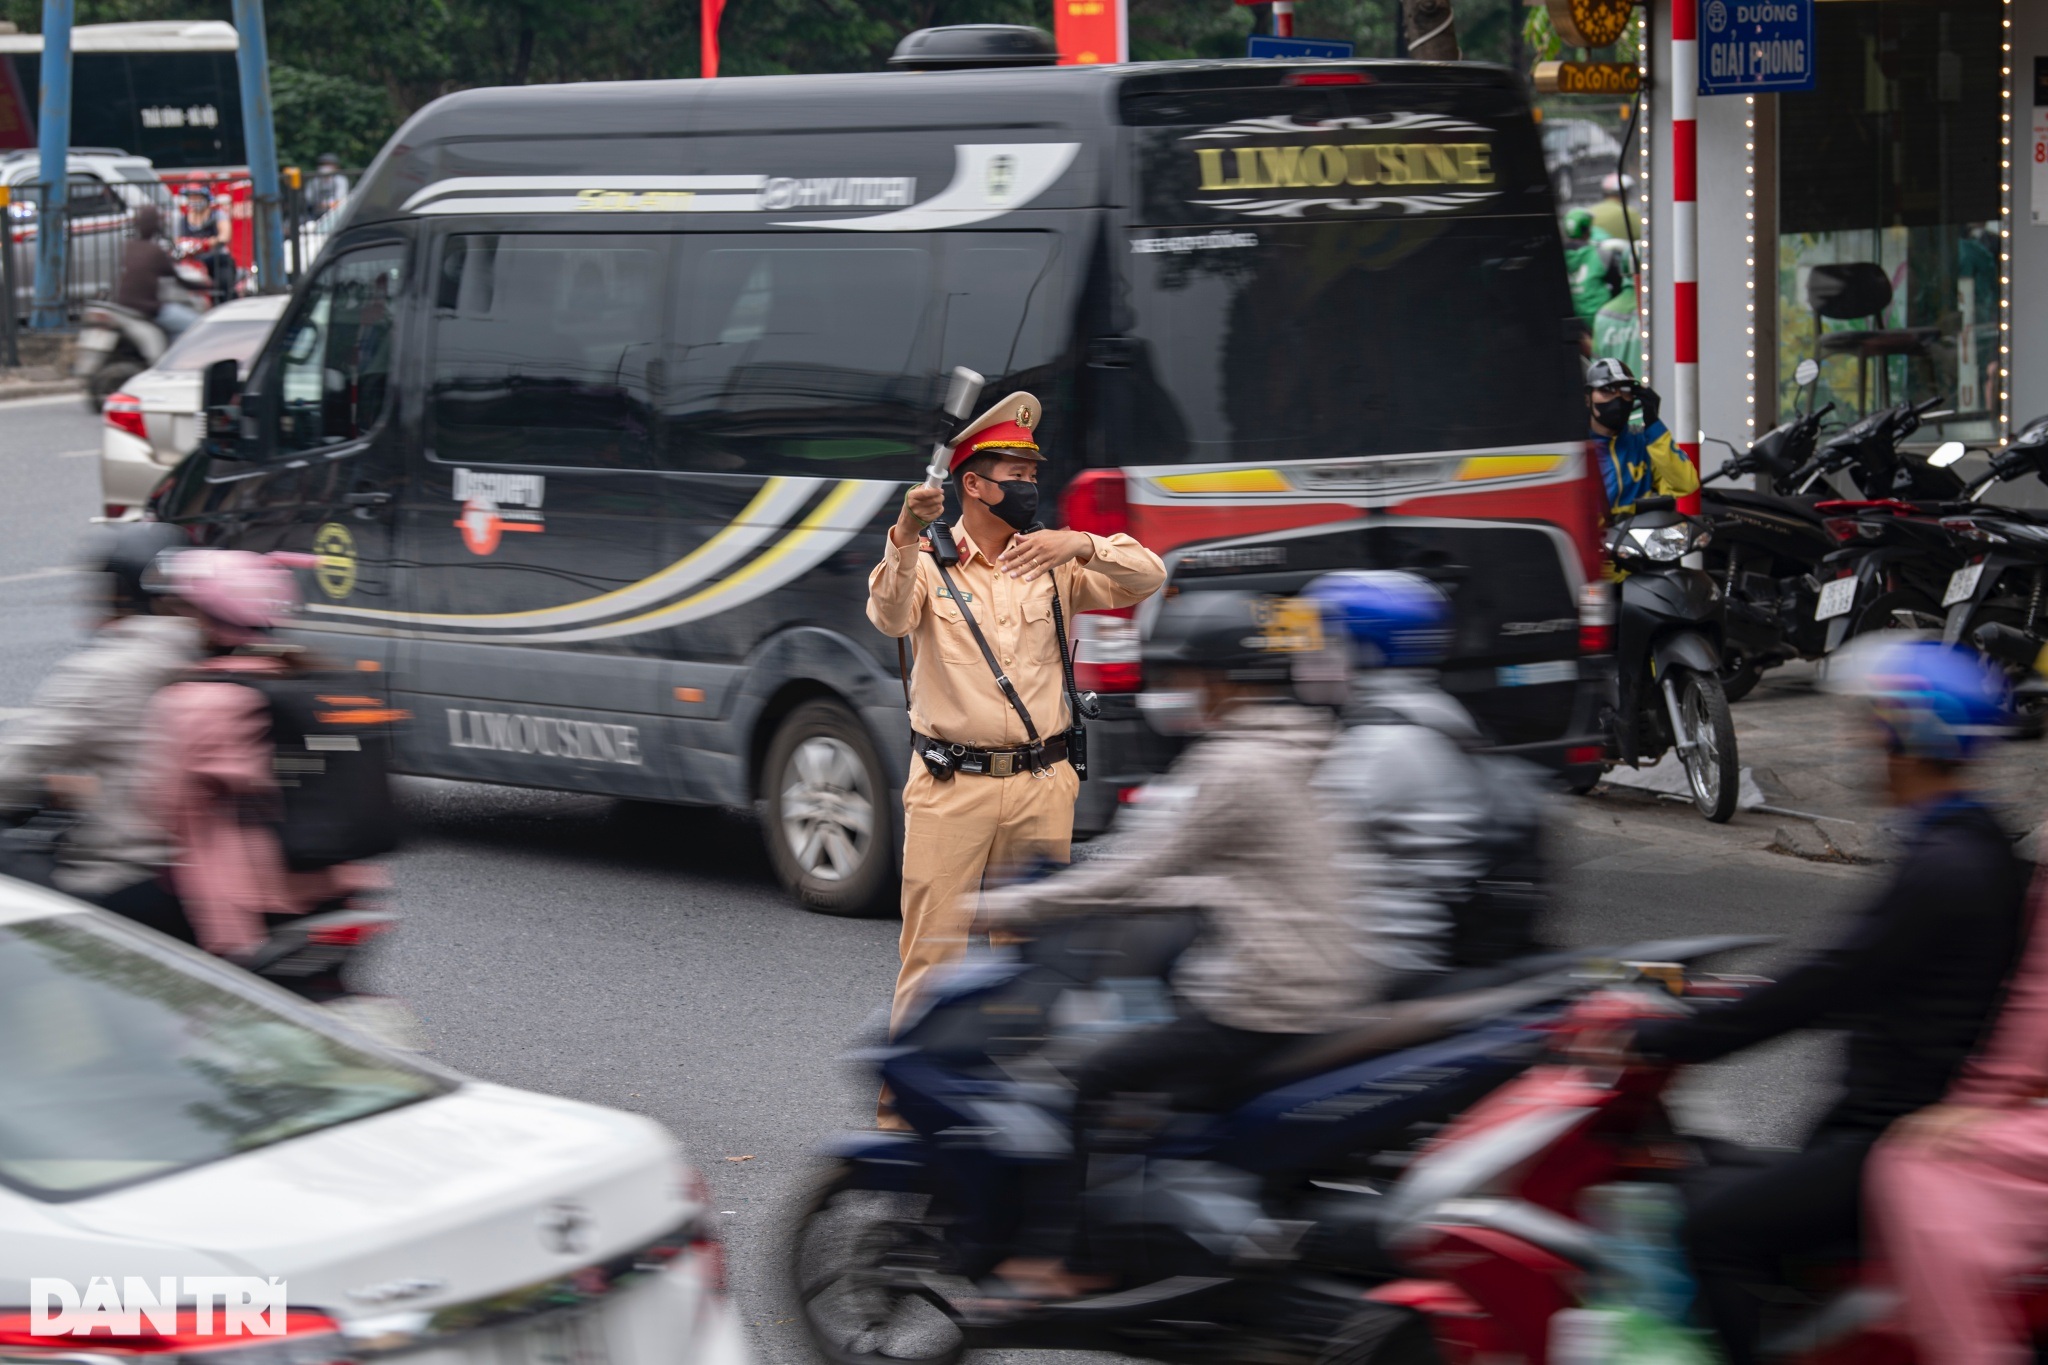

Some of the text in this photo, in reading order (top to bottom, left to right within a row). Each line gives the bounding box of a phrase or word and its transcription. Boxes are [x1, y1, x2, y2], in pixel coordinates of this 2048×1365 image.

[1737, 0, 1798, 23] ĐƯỜNG
[1711, 29, 1805, 77] GIẢI PHÓNG
[1194, 143, 1495, 190] LIMOUSINE
[445, 708, 643, 766] LIMOUSINE
